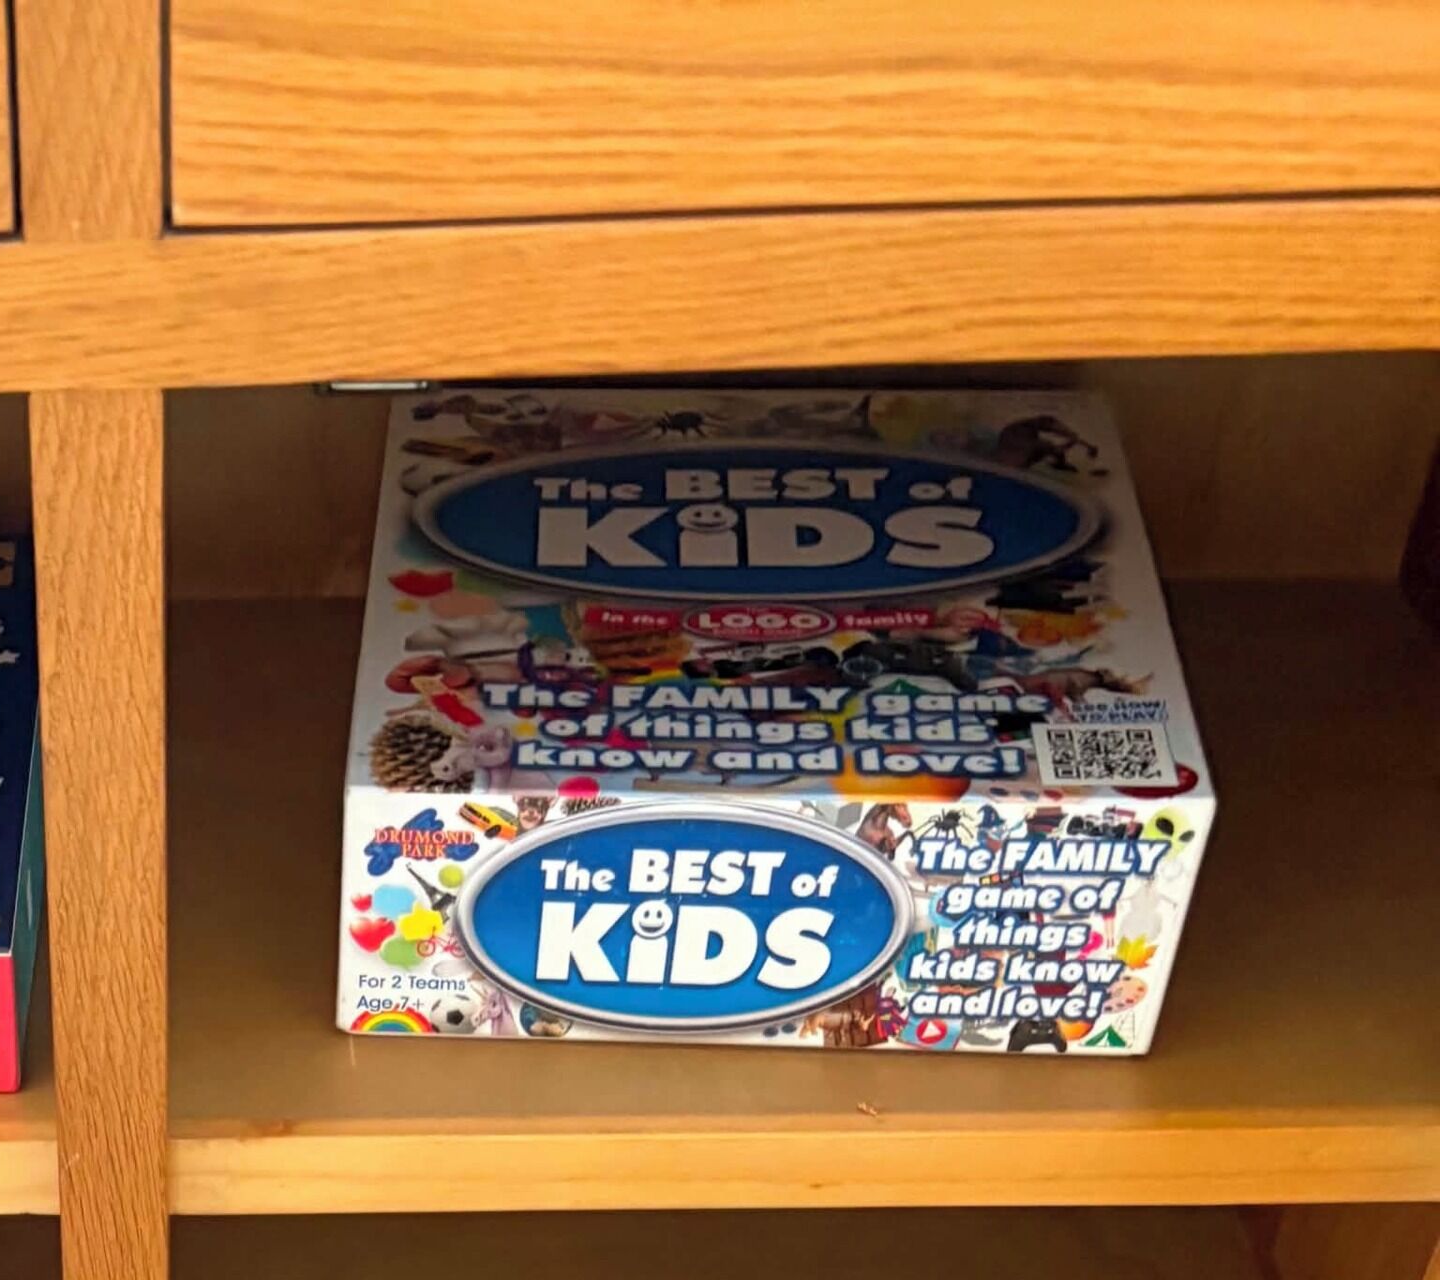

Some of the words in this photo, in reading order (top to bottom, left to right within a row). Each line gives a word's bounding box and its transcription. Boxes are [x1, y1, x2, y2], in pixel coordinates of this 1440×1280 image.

[533, 477, 645, 500] The
[665, 468, 890, 500] BEST
[908, 476, 974, 500] of
[699, 612, 823, 629] LOGO
[481, 684, 595, 708] The
[613, 685, 851, 711] FAMILY
[872, 690, 1054, 718] game
[544, 713, 610, 737] of
[626, 713, 834, 744] things
[516, 745, 694, 769] know
[713, 747, 838, 772] and
[862, 746, 1025, 774] love!
[375, 829, 475, 845] DRUMOND
[917, 842, 992, 872] The
[1003, 842, 1163, 873] FAMILY
[540, 860, 616, 892] The
[629, 849, 786, 896] BEST
[791, 864, 839, 898] of
[947, 887, 1065, 912] game
[1073, 882, 1122, 909] of
[956, 918, 1087, 950] things
[909, 953, 997, 982] kids
[1007, 956, 1122, 982] know
[359, 974, 388, 990] For
[392, 974, 403, 990] 2
[408, 974, 467, 991] Teams
[357, 995, 393, 1013] Age
[398, 995, 425, 1011] 7+
[911, 992, 991, 1018] and
[1003, 992, 1103, 1018] love!
